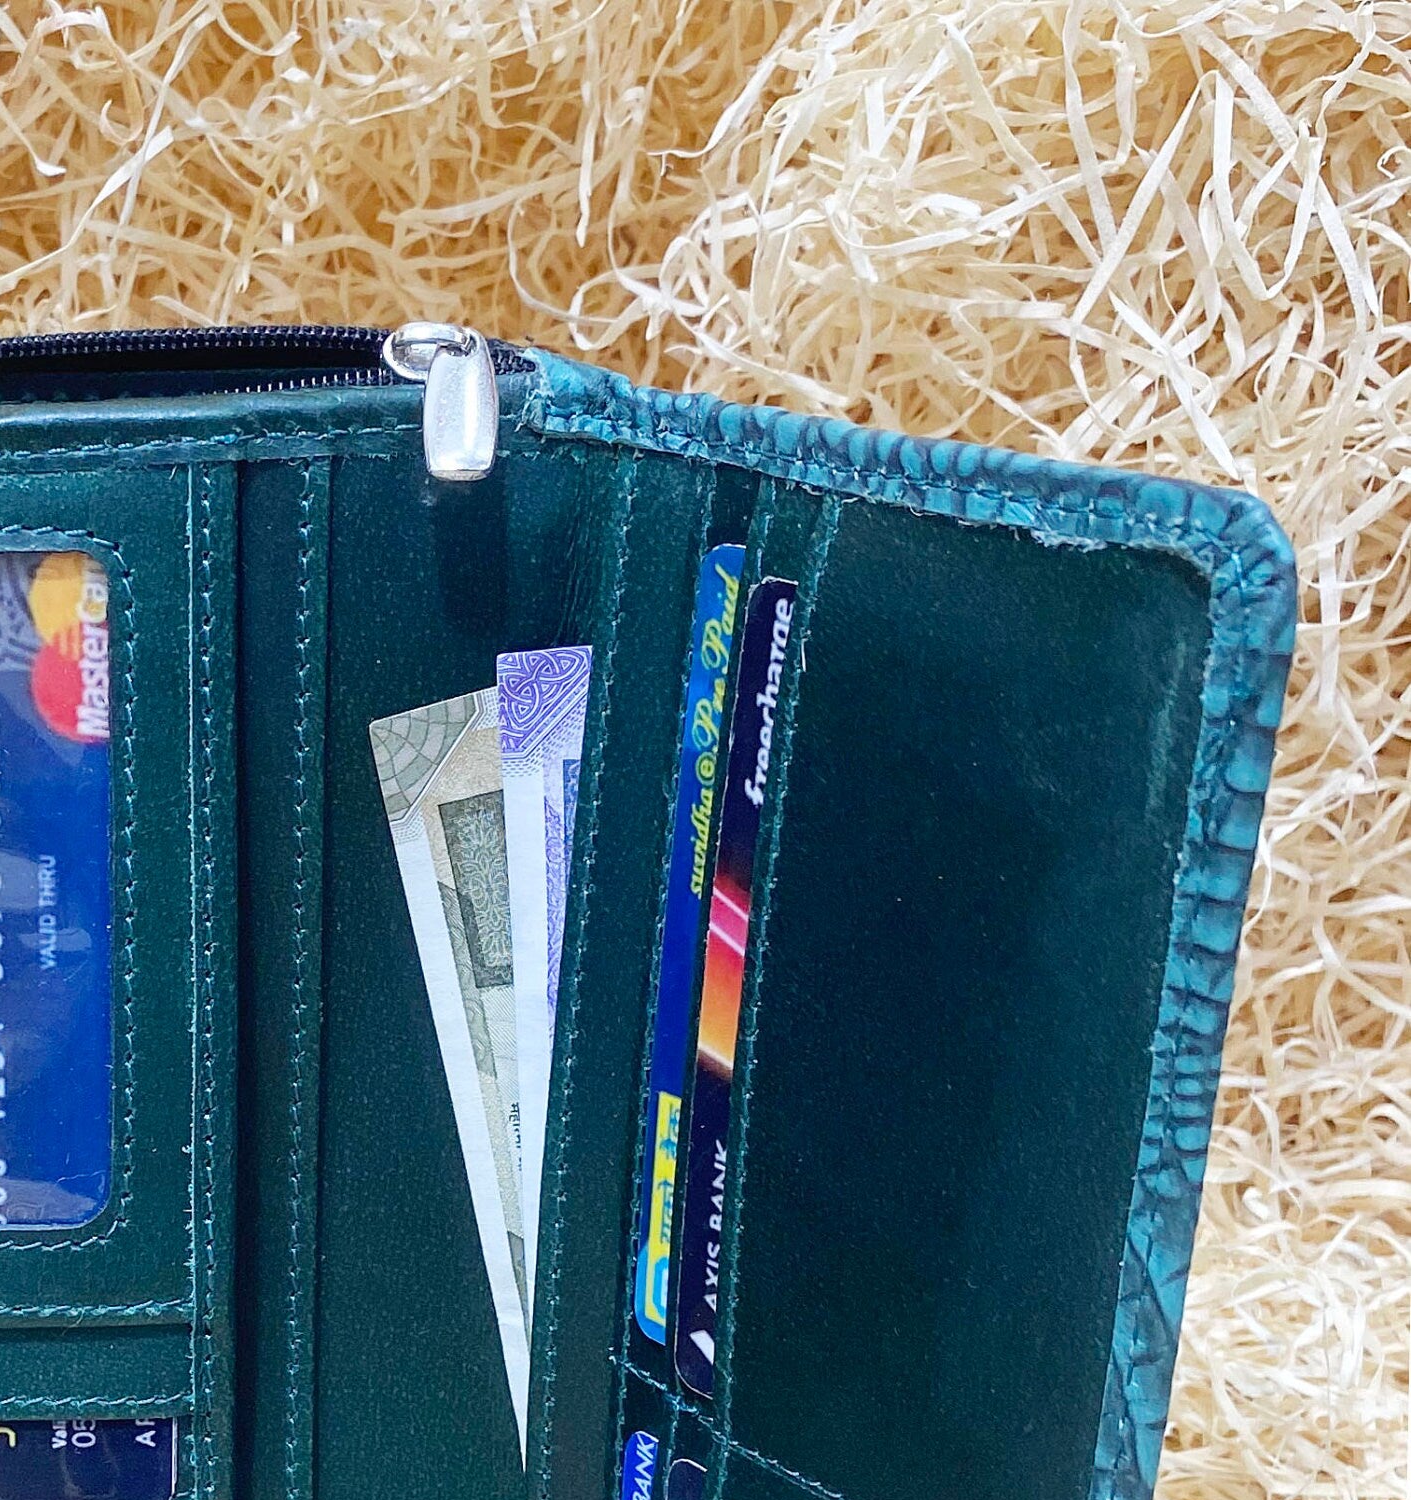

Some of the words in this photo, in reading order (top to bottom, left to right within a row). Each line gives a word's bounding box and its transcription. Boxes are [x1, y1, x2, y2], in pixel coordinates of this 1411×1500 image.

[38, 854, 58, 907] THRU
[39, 914, 58, 970] VALID
[708, 1138, 727, 1232] BANK
[703, 1241, 721, 1313] AXIS
